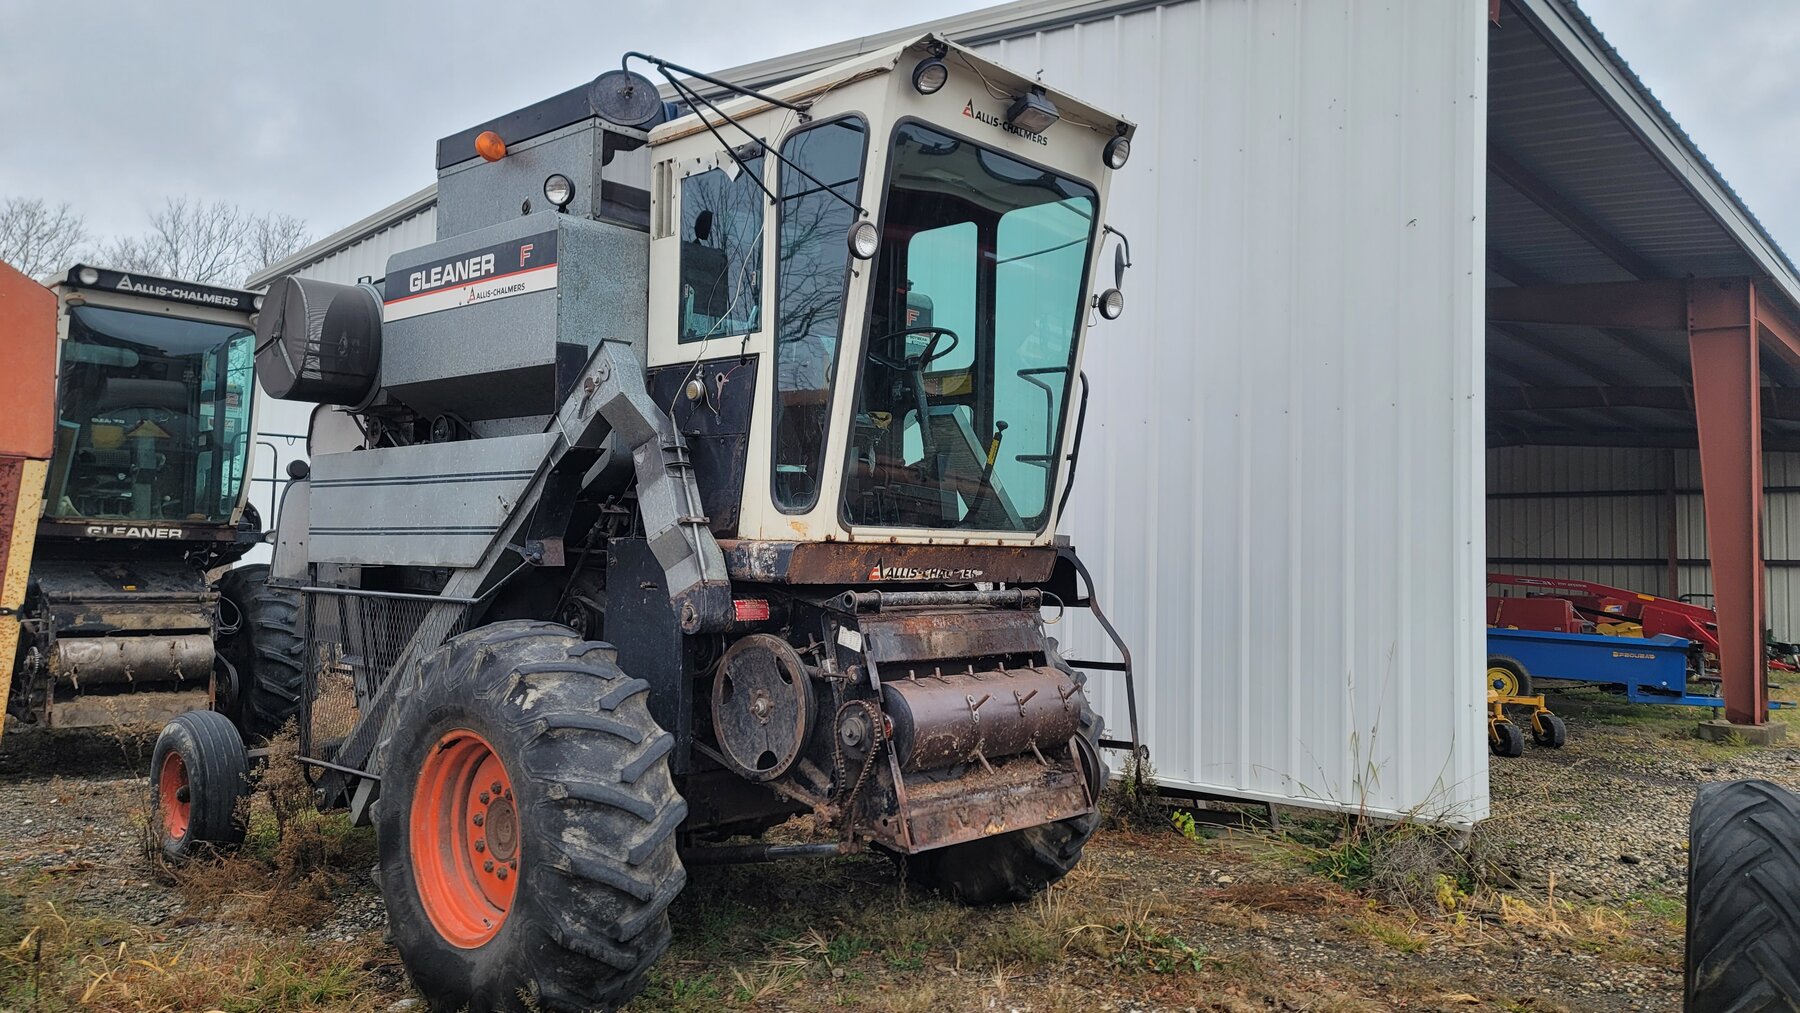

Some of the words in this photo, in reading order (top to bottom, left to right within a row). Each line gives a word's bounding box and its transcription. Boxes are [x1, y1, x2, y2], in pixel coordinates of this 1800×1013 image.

[409, 252, 495, 293] GLEANER
[519, 243, 534, 267] F
[132, 282, 239, 307] ALLIS-CHALMERS
[476, 282, 526, 300] ALLIS-CHALMERS
[906, 308, 920, 327] F
